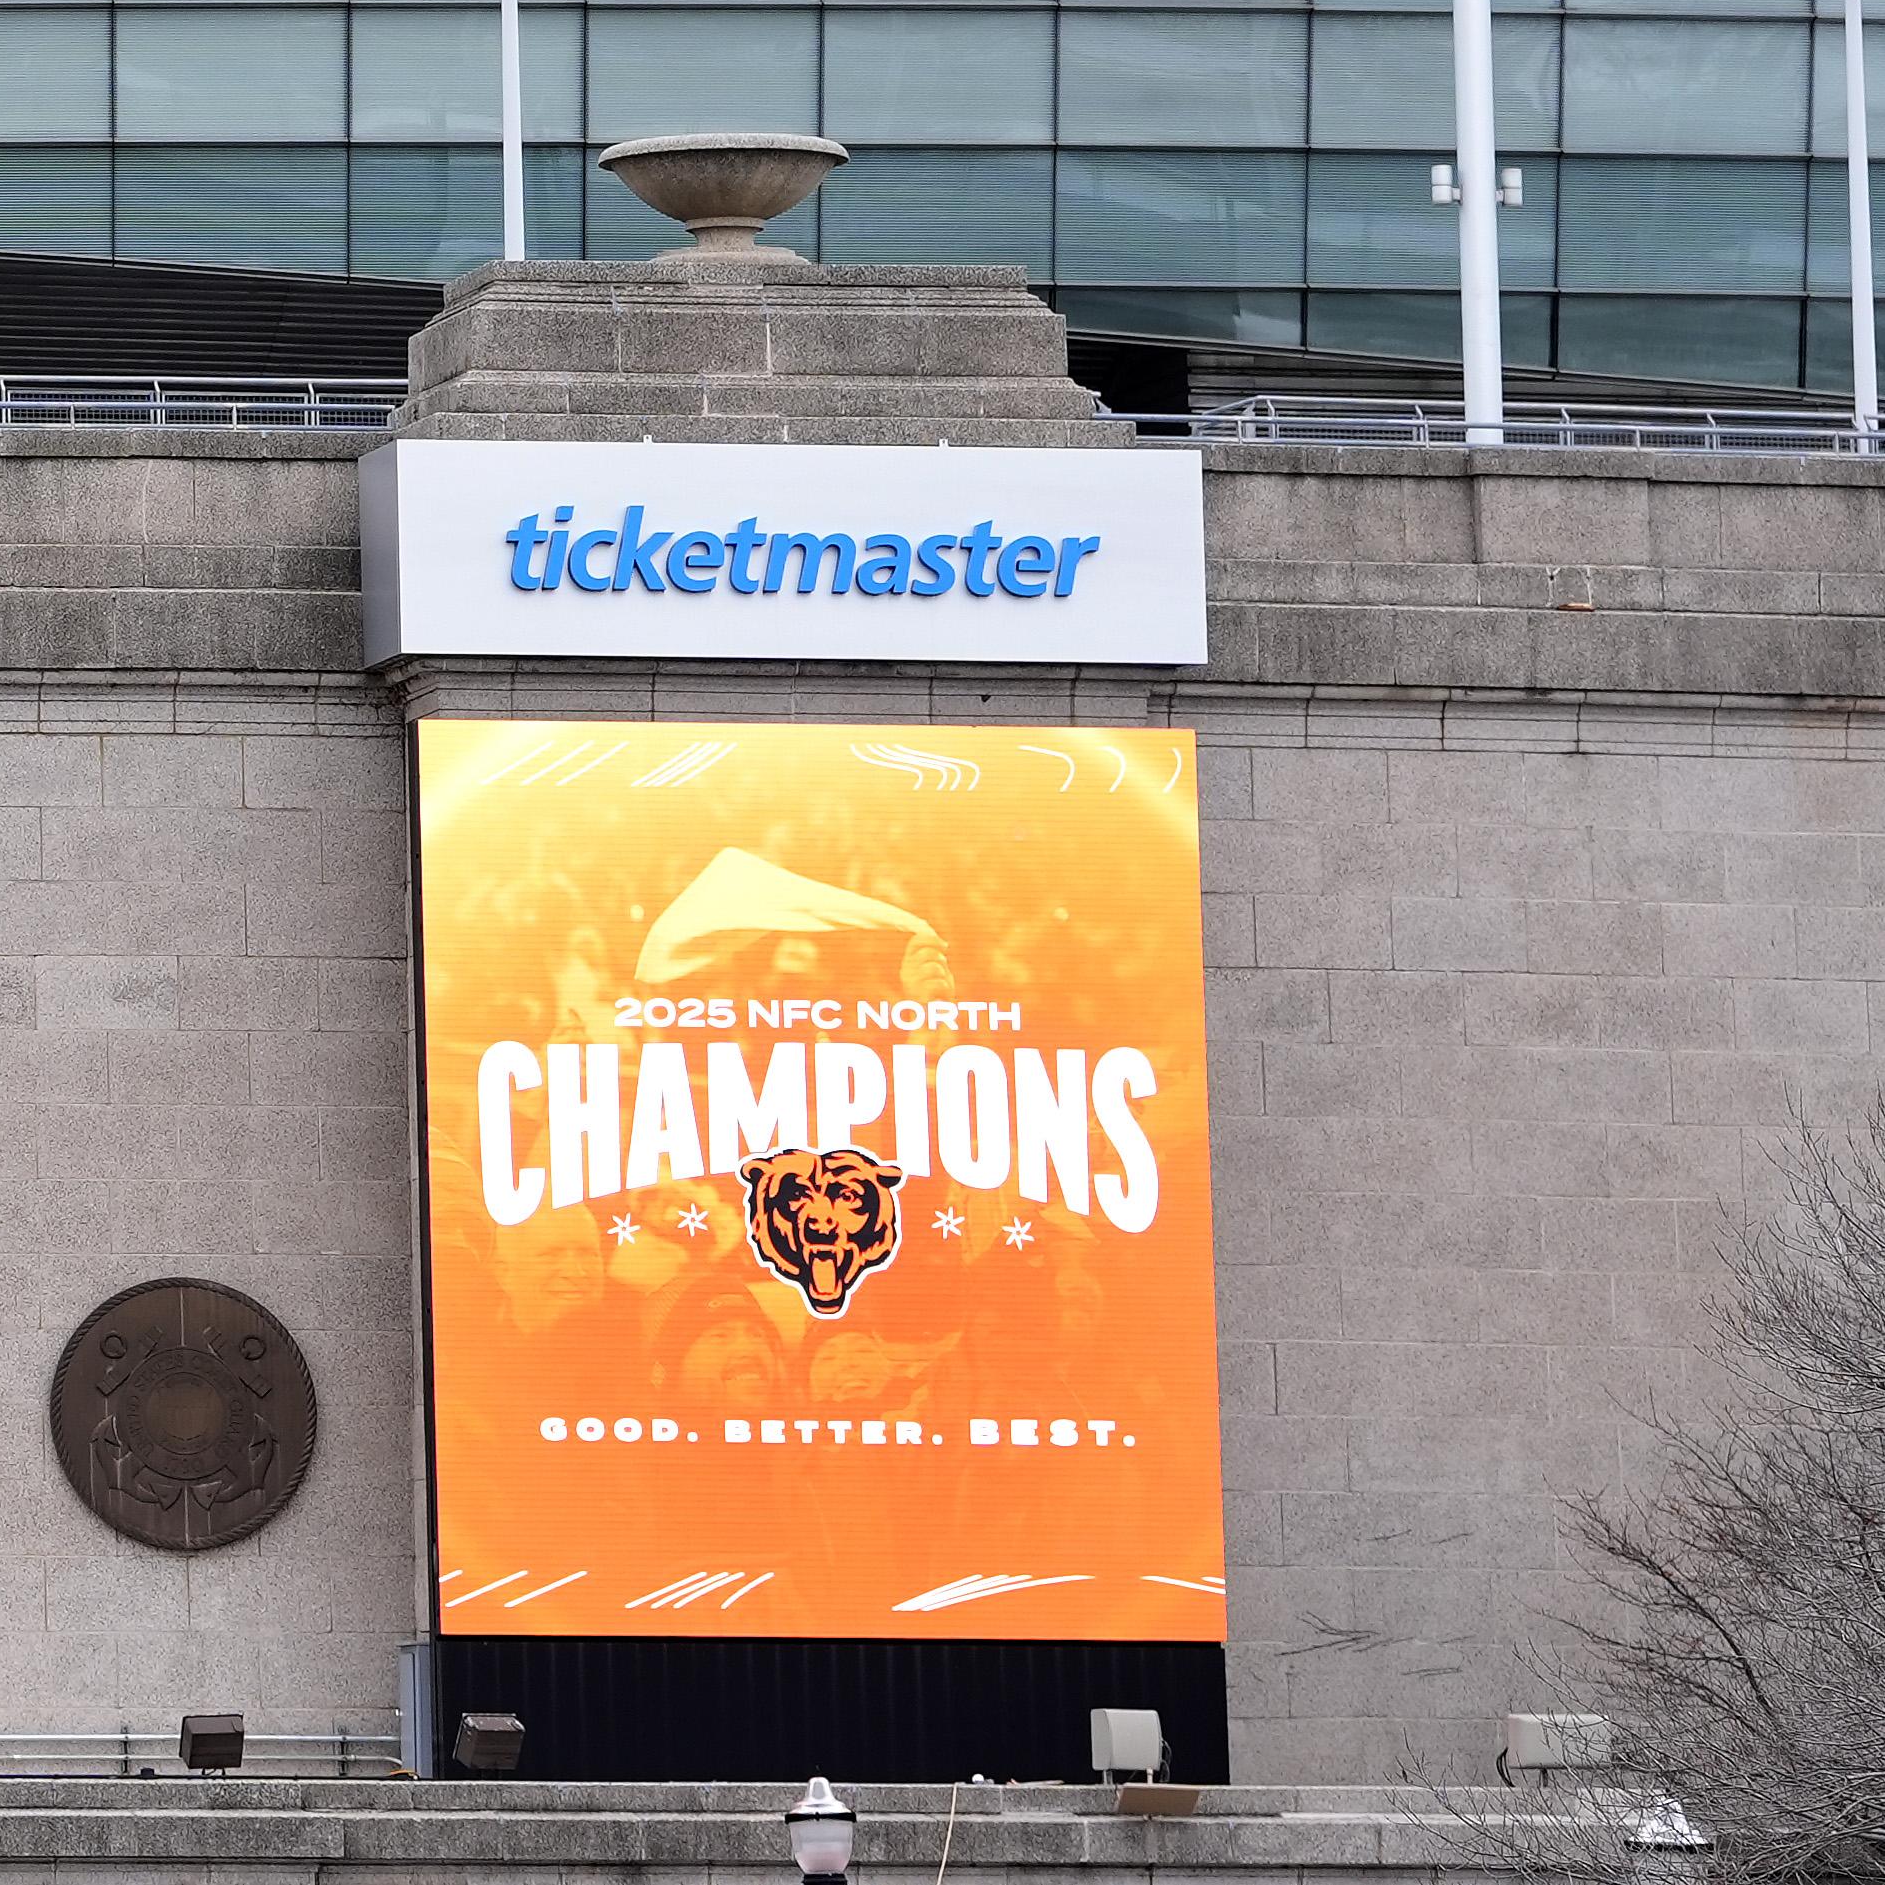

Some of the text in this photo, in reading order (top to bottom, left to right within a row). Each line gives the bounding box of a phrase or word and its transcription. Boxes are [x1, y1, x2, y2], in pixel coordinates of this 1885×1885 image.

[505, 504, 1101, 599] ticketmaster
[613, 997, 1022, 1032] 2025 NFC NORTH
[477, 1040, 1160, 1234] CHAMPIONS
[539, 1416, 1137, 1448] GOOD. BETTER. BEST.
